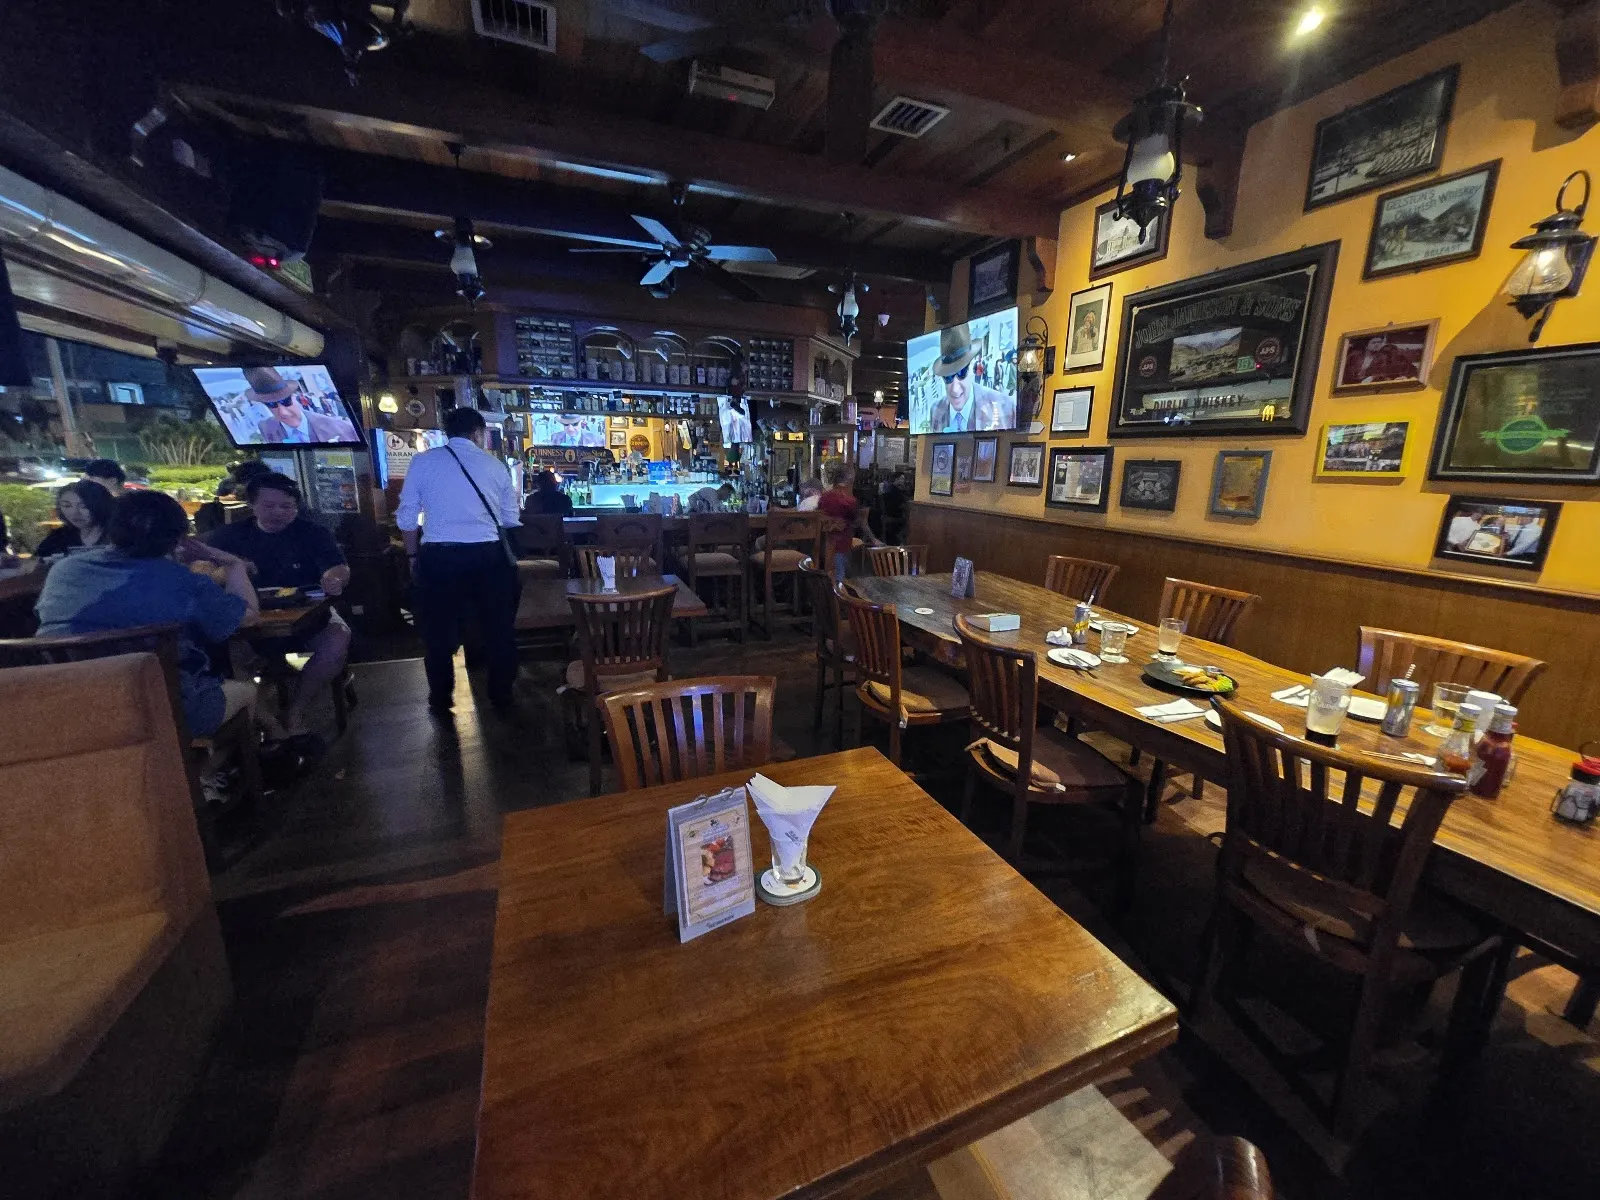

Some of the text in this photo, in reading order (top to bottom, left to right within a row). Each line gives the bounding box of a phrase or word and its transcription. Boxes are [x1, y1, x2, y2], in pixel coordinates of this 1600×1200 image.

[1153, 393, 1245, 411] DUBLIN WHISKEY
[529, 447, 564, 458] GUINNESS
